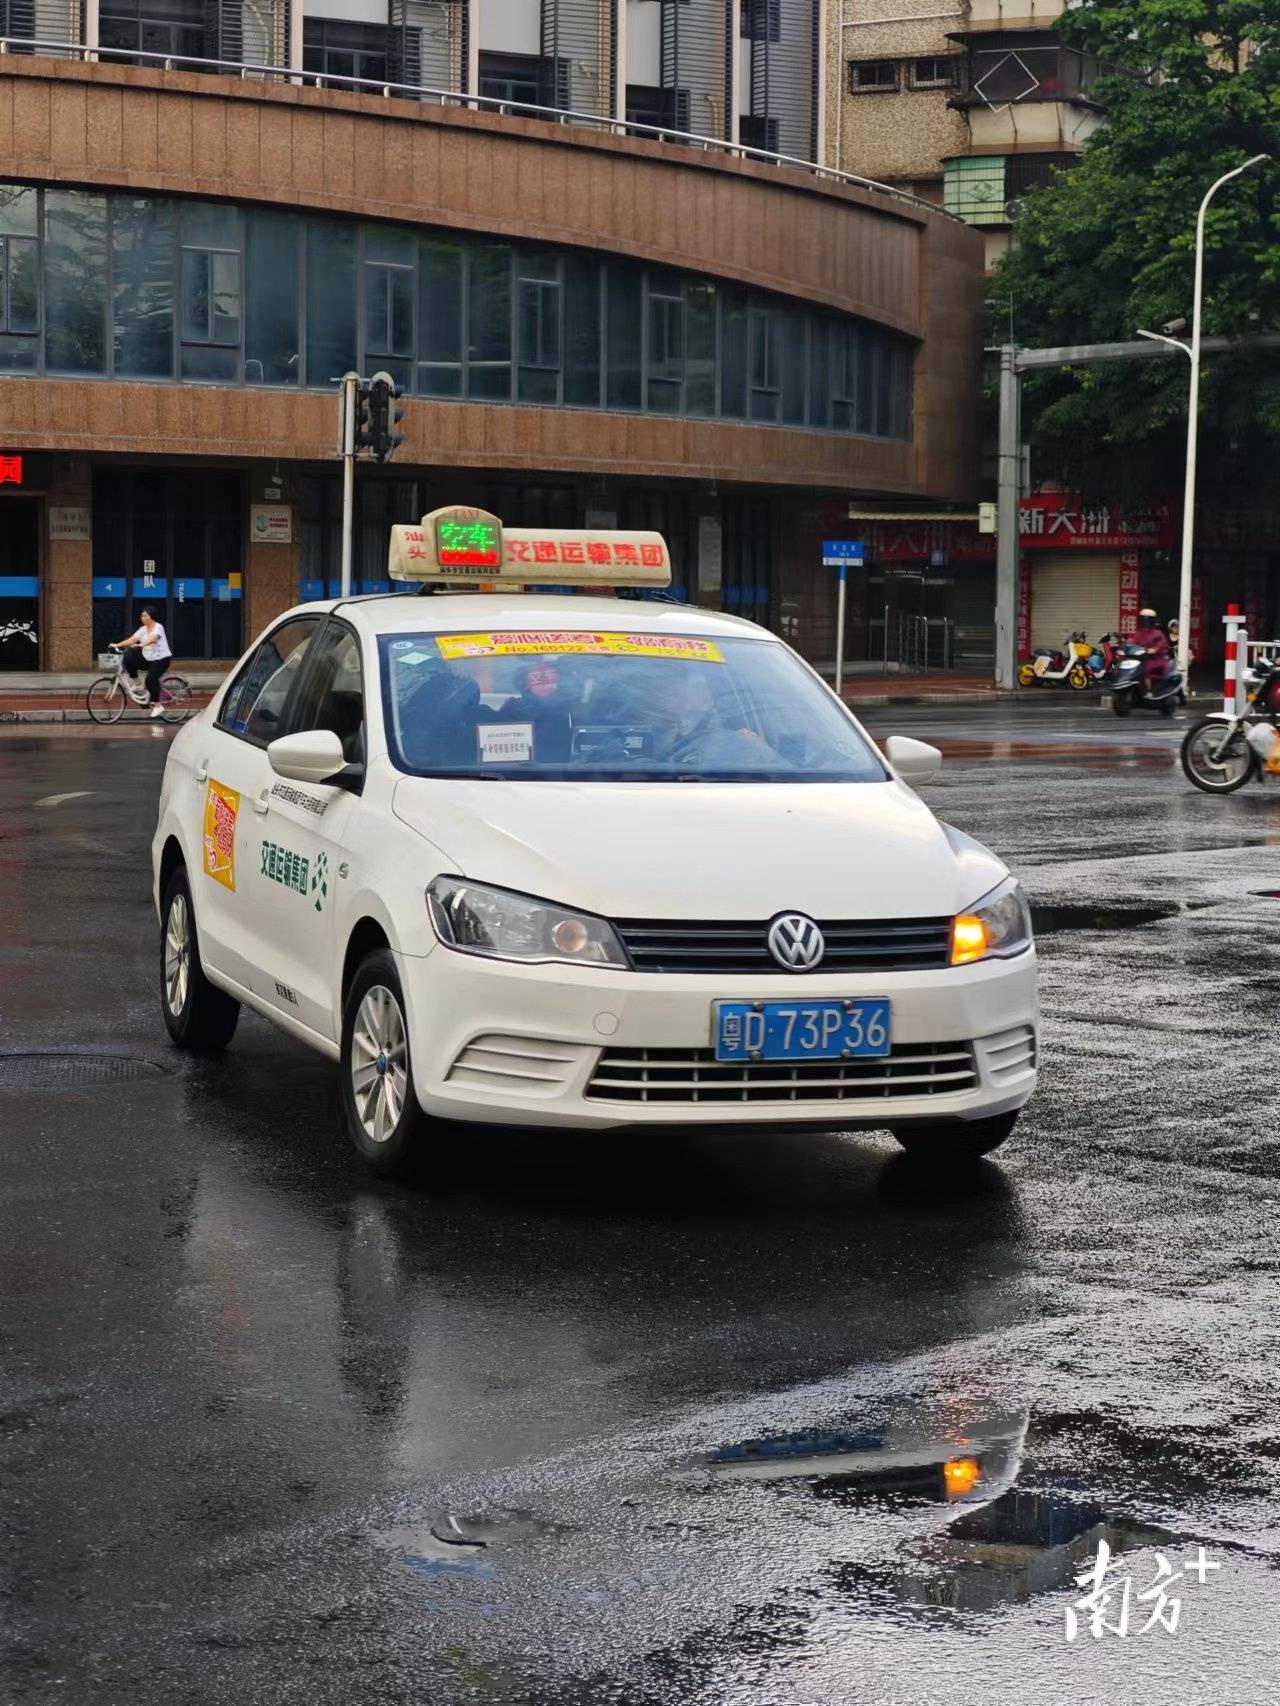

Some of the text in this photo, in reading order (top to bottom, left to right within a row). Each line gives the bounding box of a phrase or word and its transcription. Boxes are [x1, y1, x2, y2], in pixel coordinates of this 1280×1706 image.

[1019, 507, 1111, 534] 新大洲
[404, 531, 427, 560] 汕头
[505, 540, 665, 567] 交通运输集团
[143, 559, 156, 588] 团队
[1121, 551, 1138, 642] 电动车维
[261, 840, 309, 895] 交通运输集团
[770, 915, 824, 971] VW
